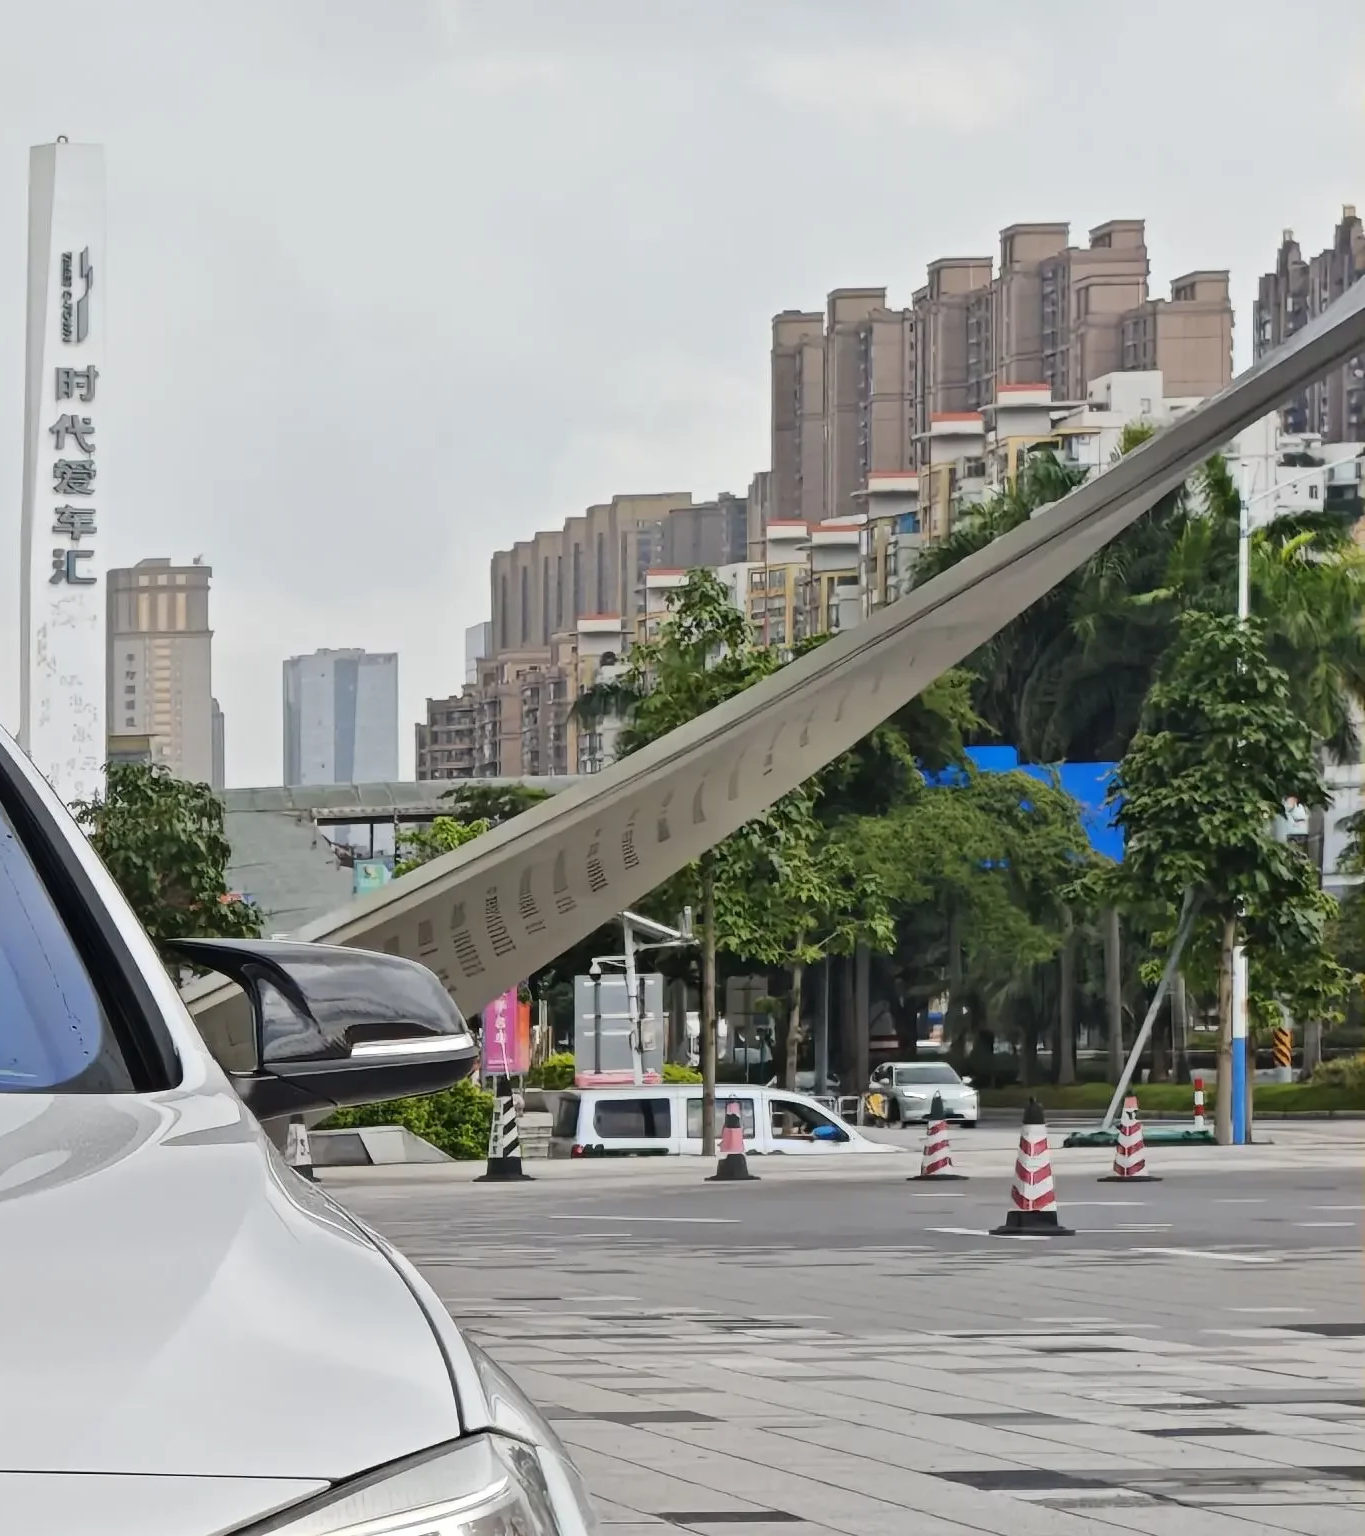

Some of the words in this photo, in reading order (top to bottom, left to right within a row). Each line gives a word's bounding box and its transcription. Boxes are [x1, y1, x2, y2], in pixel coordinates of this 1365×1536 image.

[48, 364, 100, 585] 时代爱车汇
